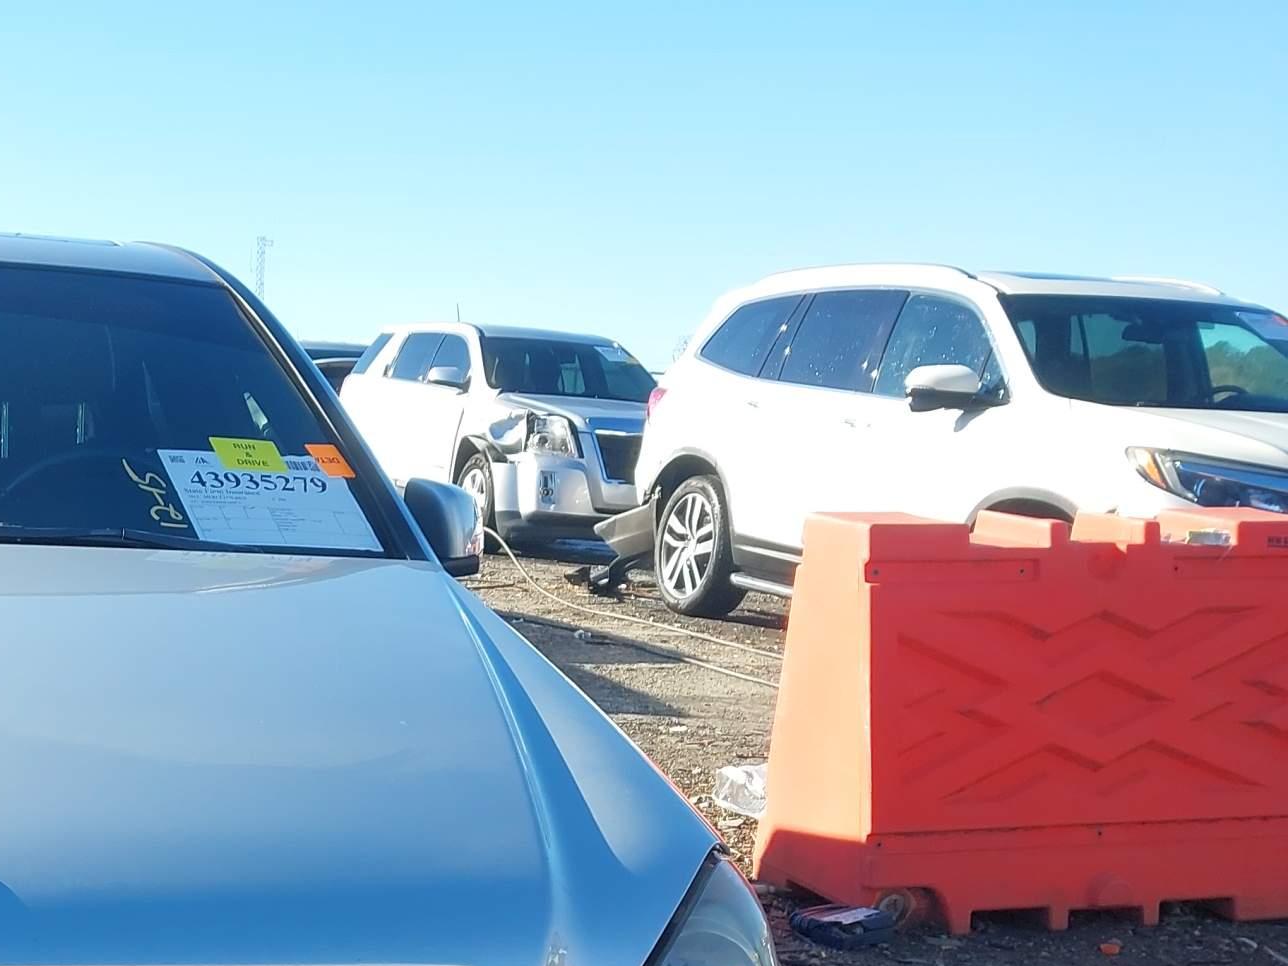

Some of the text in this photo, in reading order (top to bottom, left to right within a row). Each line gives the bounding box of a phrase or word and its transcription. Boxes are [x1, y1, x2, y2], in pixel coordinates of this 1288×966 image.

[232, 442, 256, 451] RUN
[236, 458, 270, 467] DRIVE
[190, 470, 328, 495] 43935279
